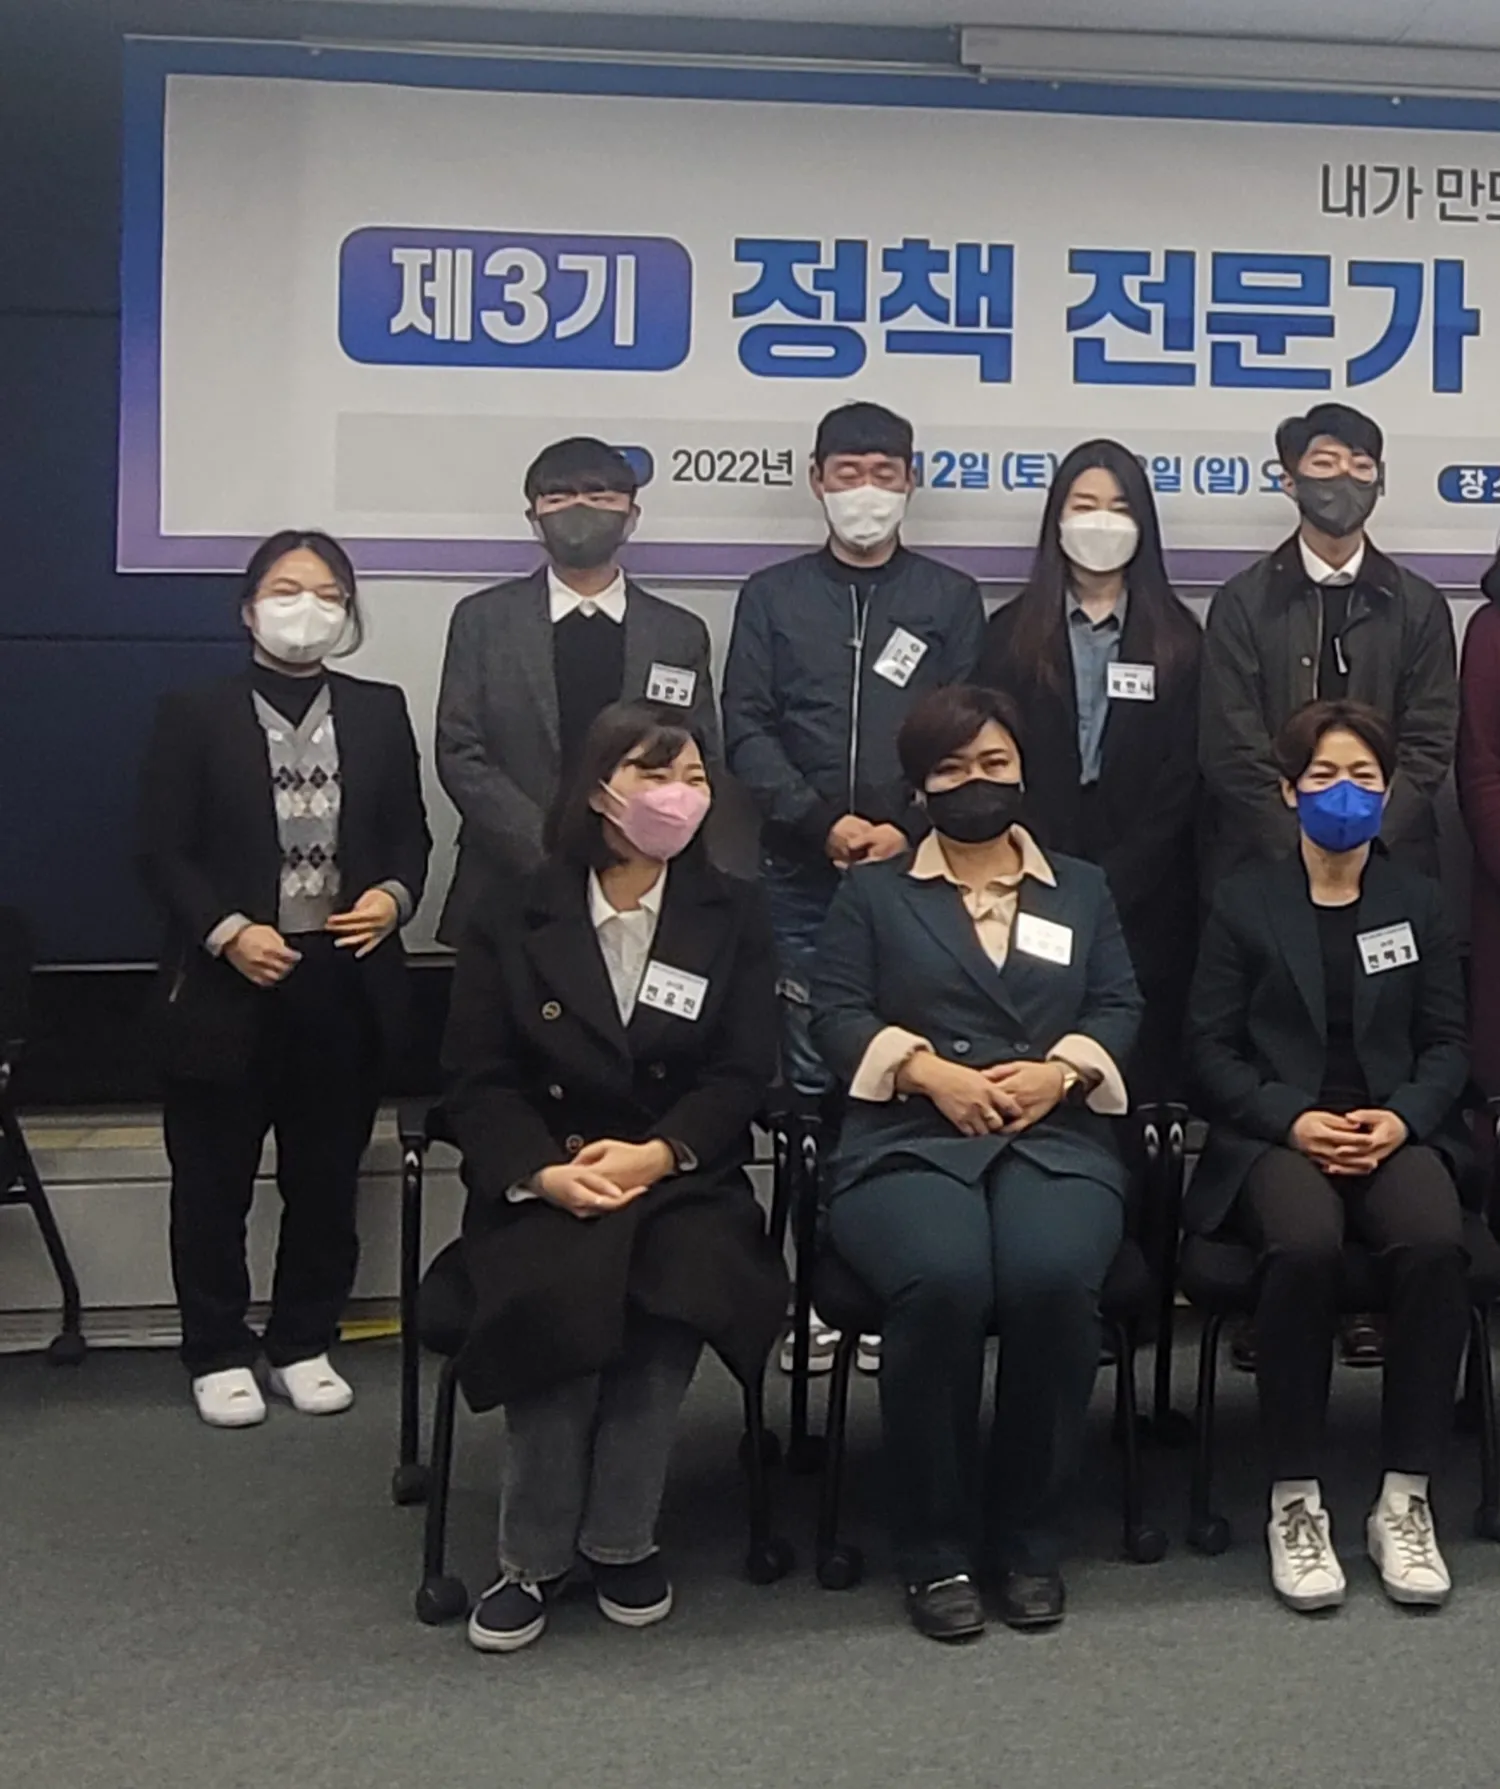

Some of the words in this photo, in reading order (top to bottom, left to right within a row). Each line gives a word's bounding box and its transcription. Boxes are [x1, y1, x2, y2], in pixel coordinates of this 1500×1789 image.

[1321, 163, 1424, 221] 내가
[389, 247, 636, 346] 제3기
[732, 237, 1015, 384] 정책
[1066, 248, 1481, 394] 전문가
[671, 448, 794, 487] 2022년
[1193, 455, 1250, 495] (일)
